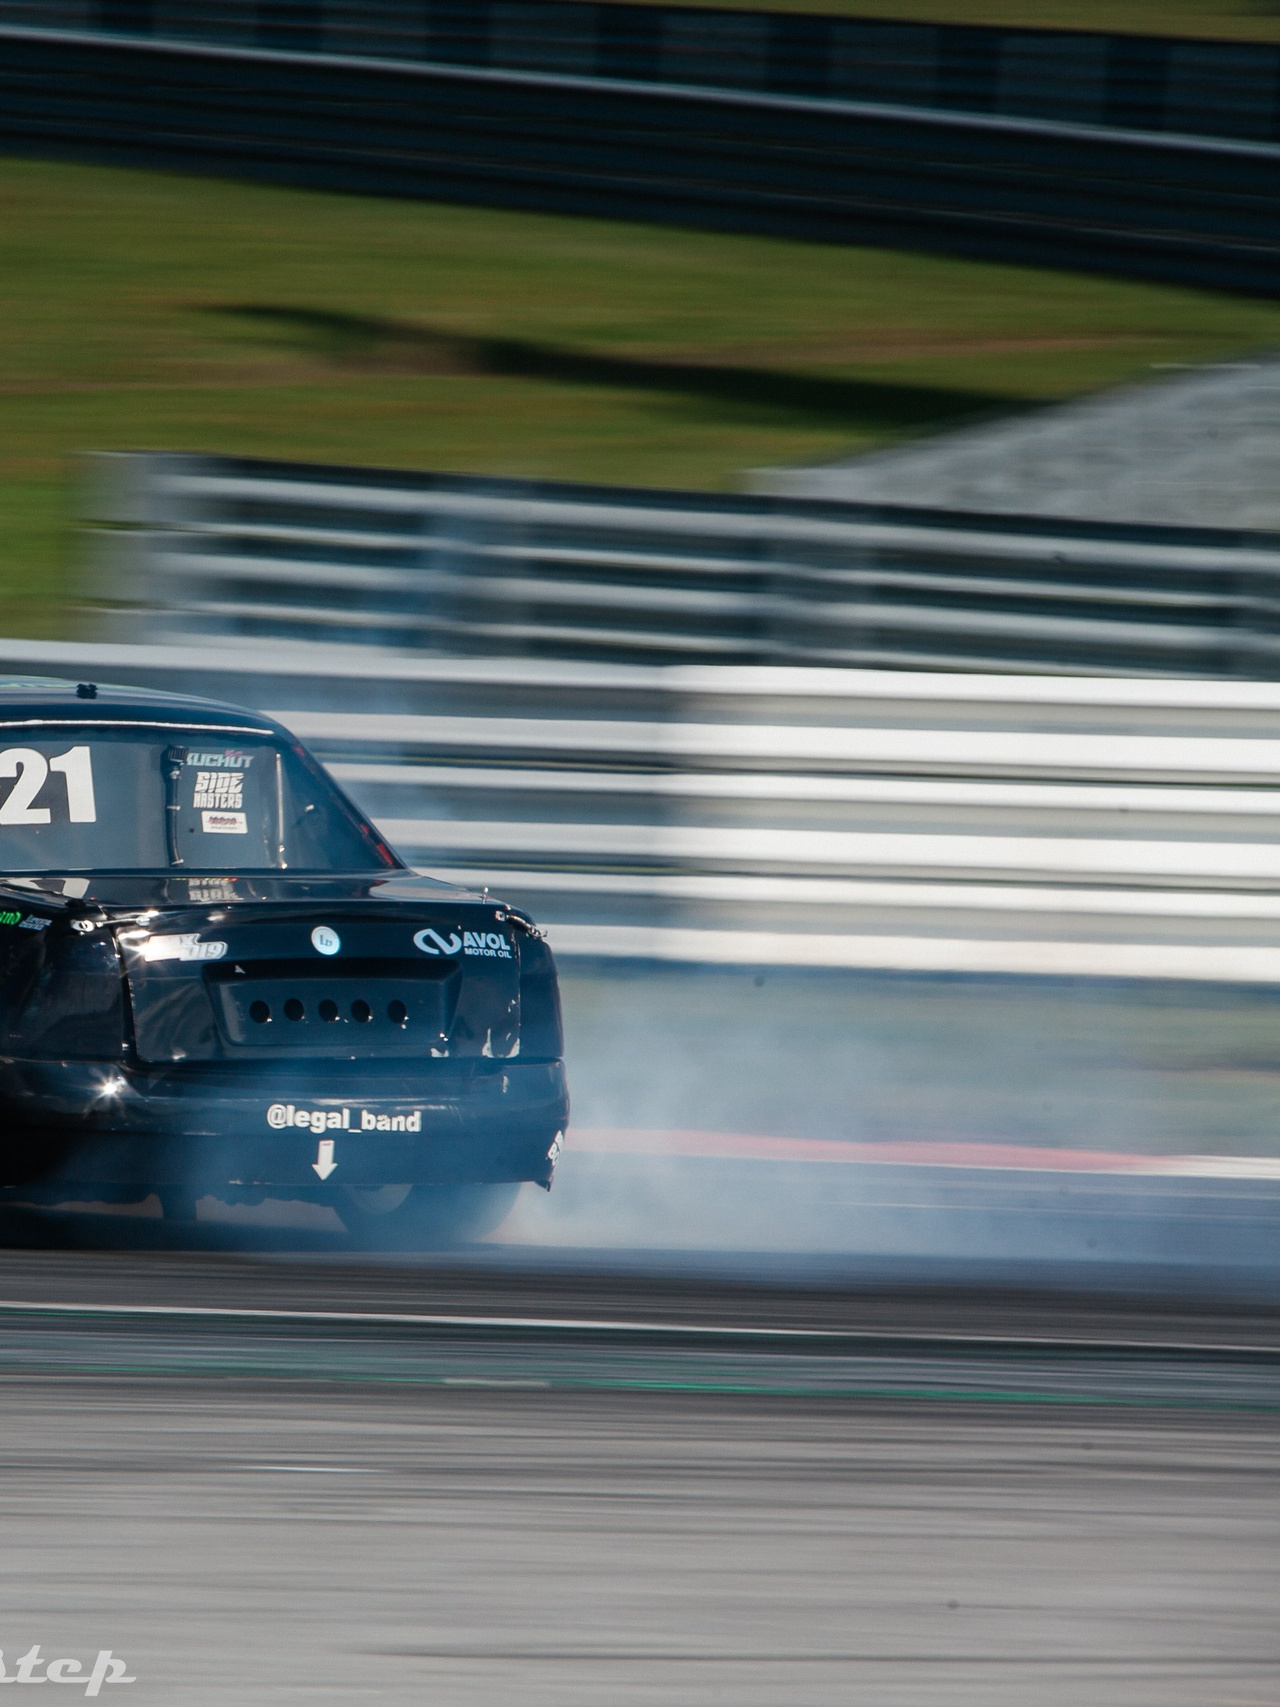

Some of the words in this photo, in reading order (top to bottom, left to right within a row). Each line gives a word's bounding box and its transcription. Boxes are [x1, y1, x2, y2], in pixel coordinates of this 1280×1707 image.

[194, 771, 245, 794] SIDE
[192, 792, 244, 809] MASTERS
[463, 931, 511, 950] AVOL
[464, 947, 497, 957] MOTOR
[497, 950, 513, 959] OIL
[267, 1104, 422, 1134] @legal_band
